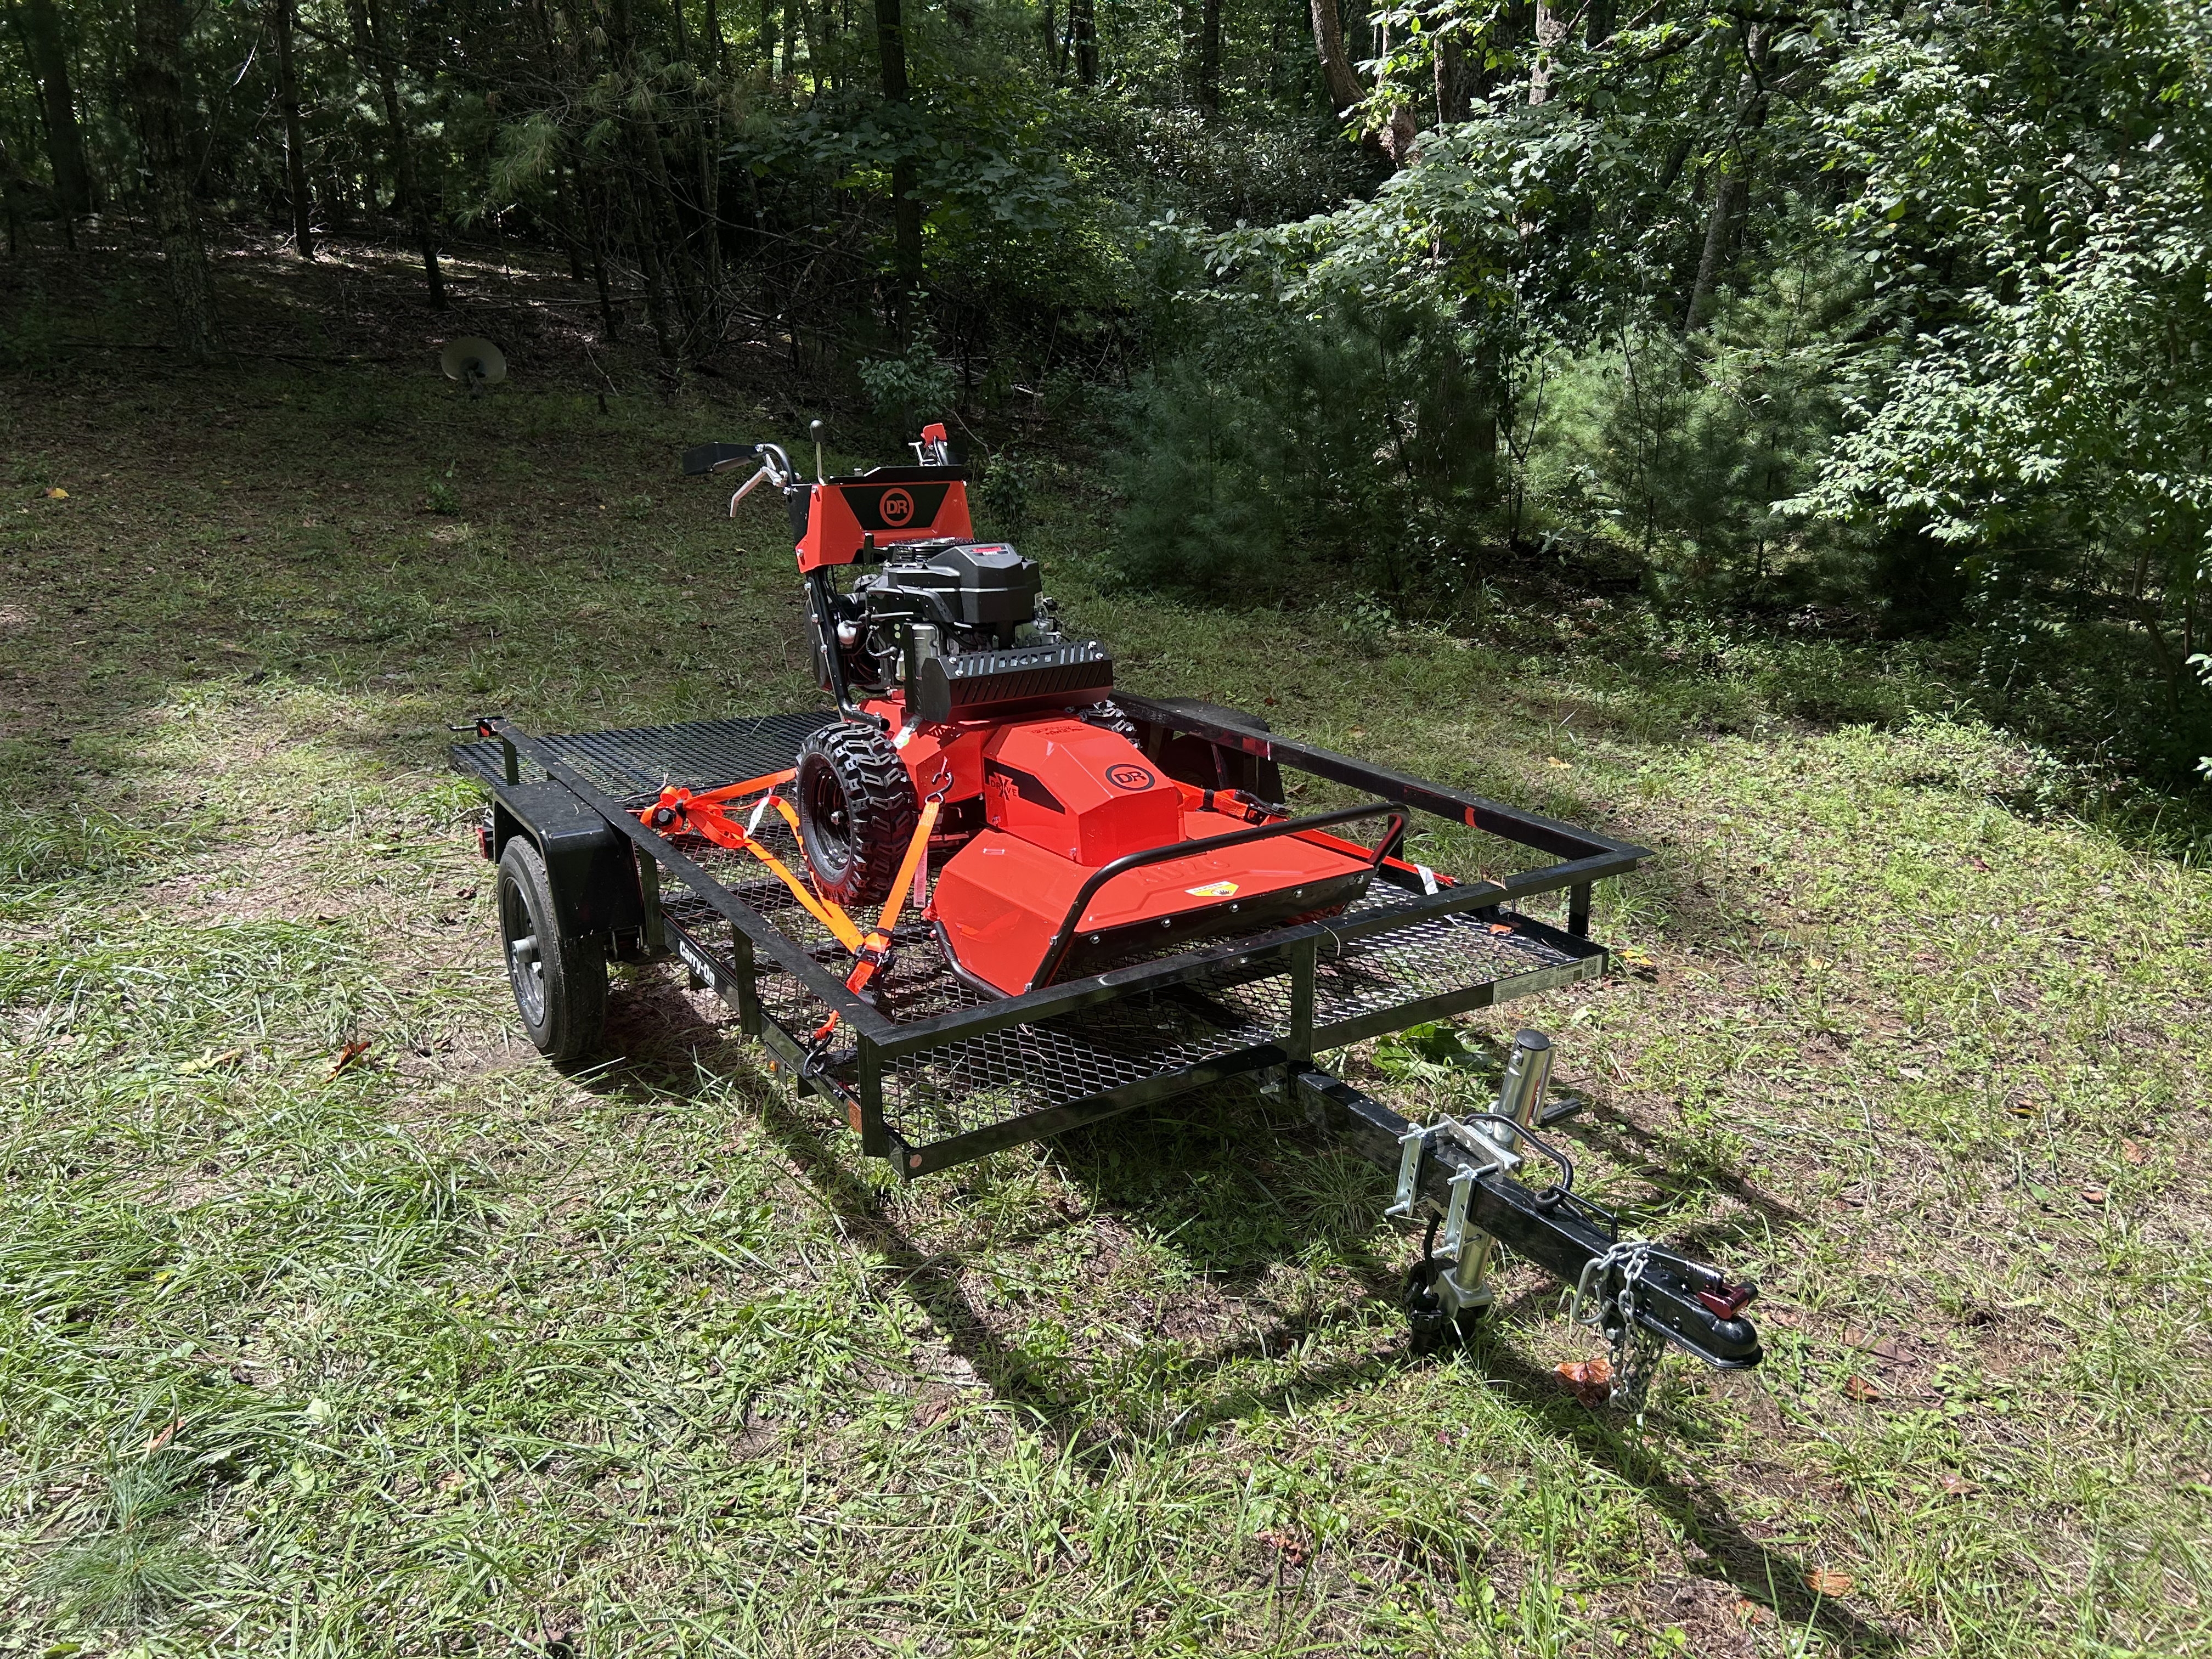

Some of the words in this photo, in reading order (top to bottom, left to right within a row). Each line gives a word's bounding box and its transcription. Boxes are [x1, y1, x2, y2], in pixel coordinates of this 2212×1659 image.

[887, 500, 907, 514] DR
[1114, 771, 1147, 783] DR
[679, 940, 715, 986] Carry-On
